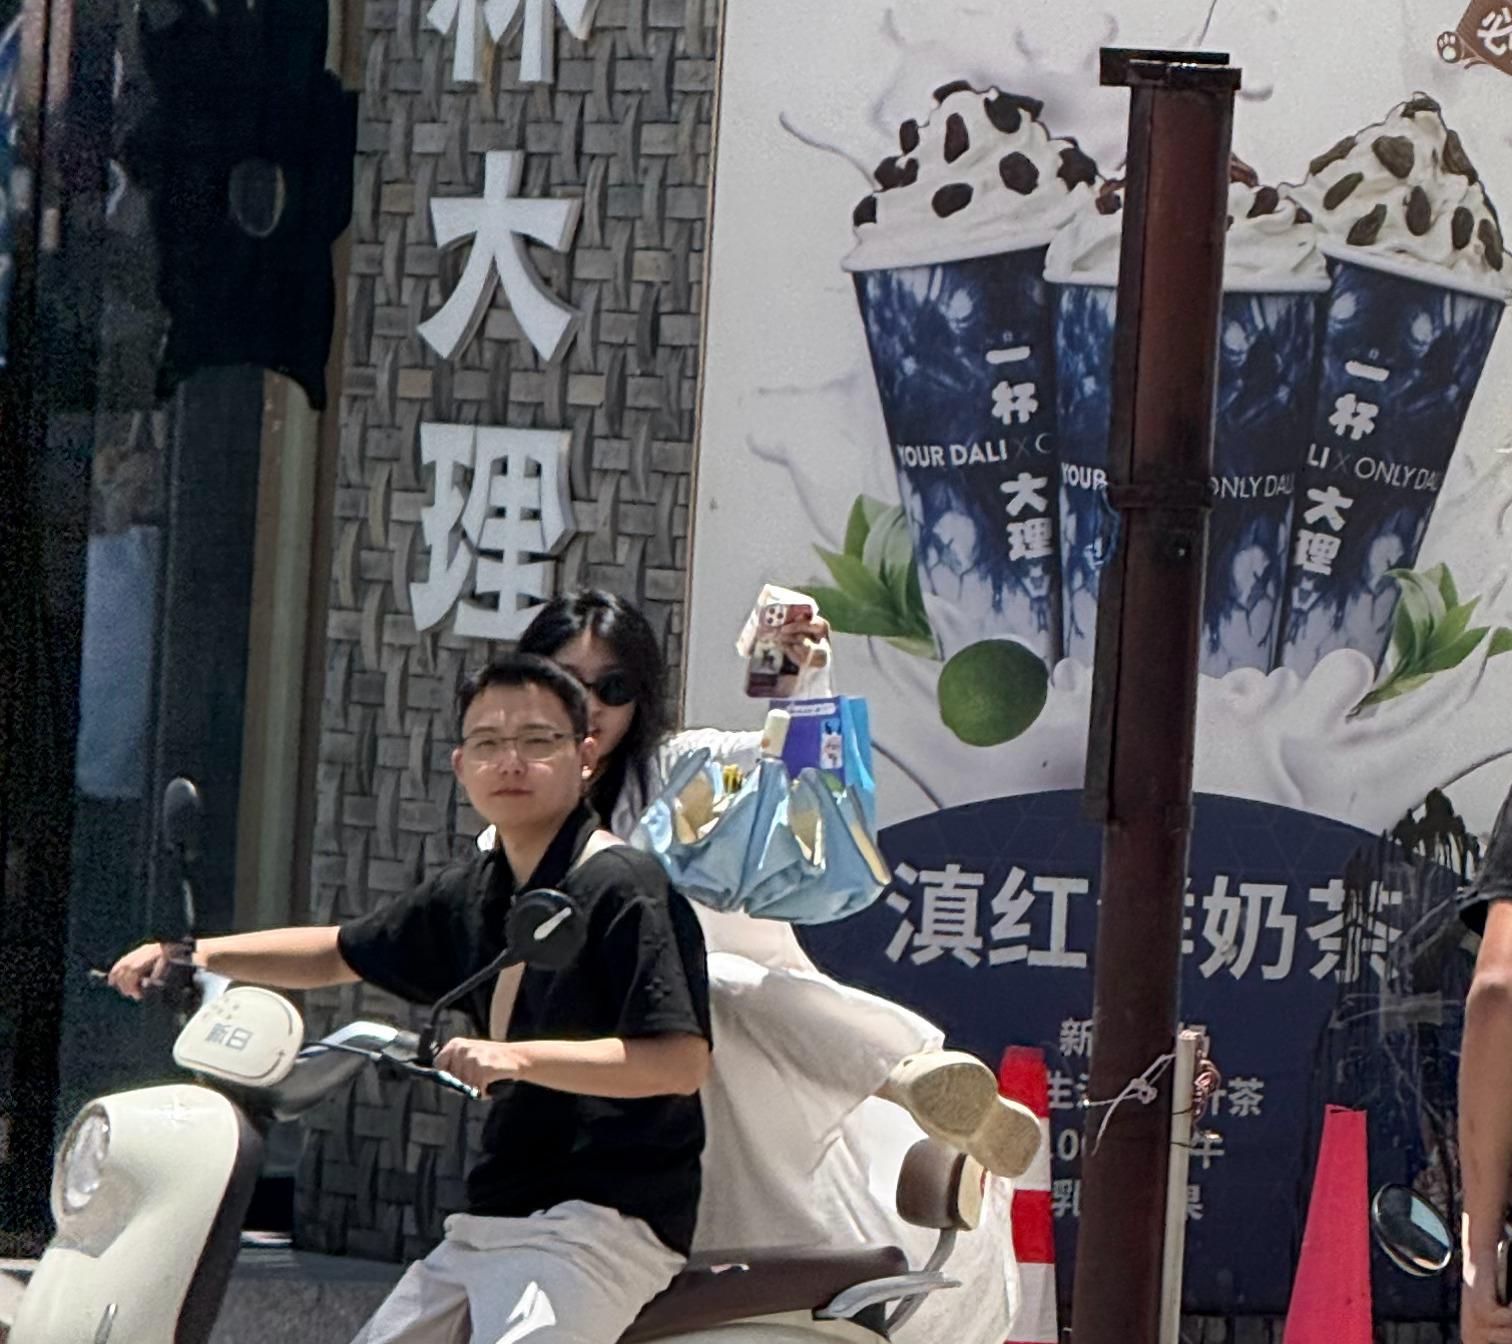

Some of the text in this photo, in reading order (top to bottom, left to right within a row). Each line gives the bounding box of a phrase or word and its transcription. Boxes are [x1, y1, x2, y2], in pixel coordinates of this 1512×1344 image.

[949, 438, 1007, 466] DALI
[1354, 457, 1416, 489] ONLY
[885, 863, 1402, 982] 滇红奶茶
